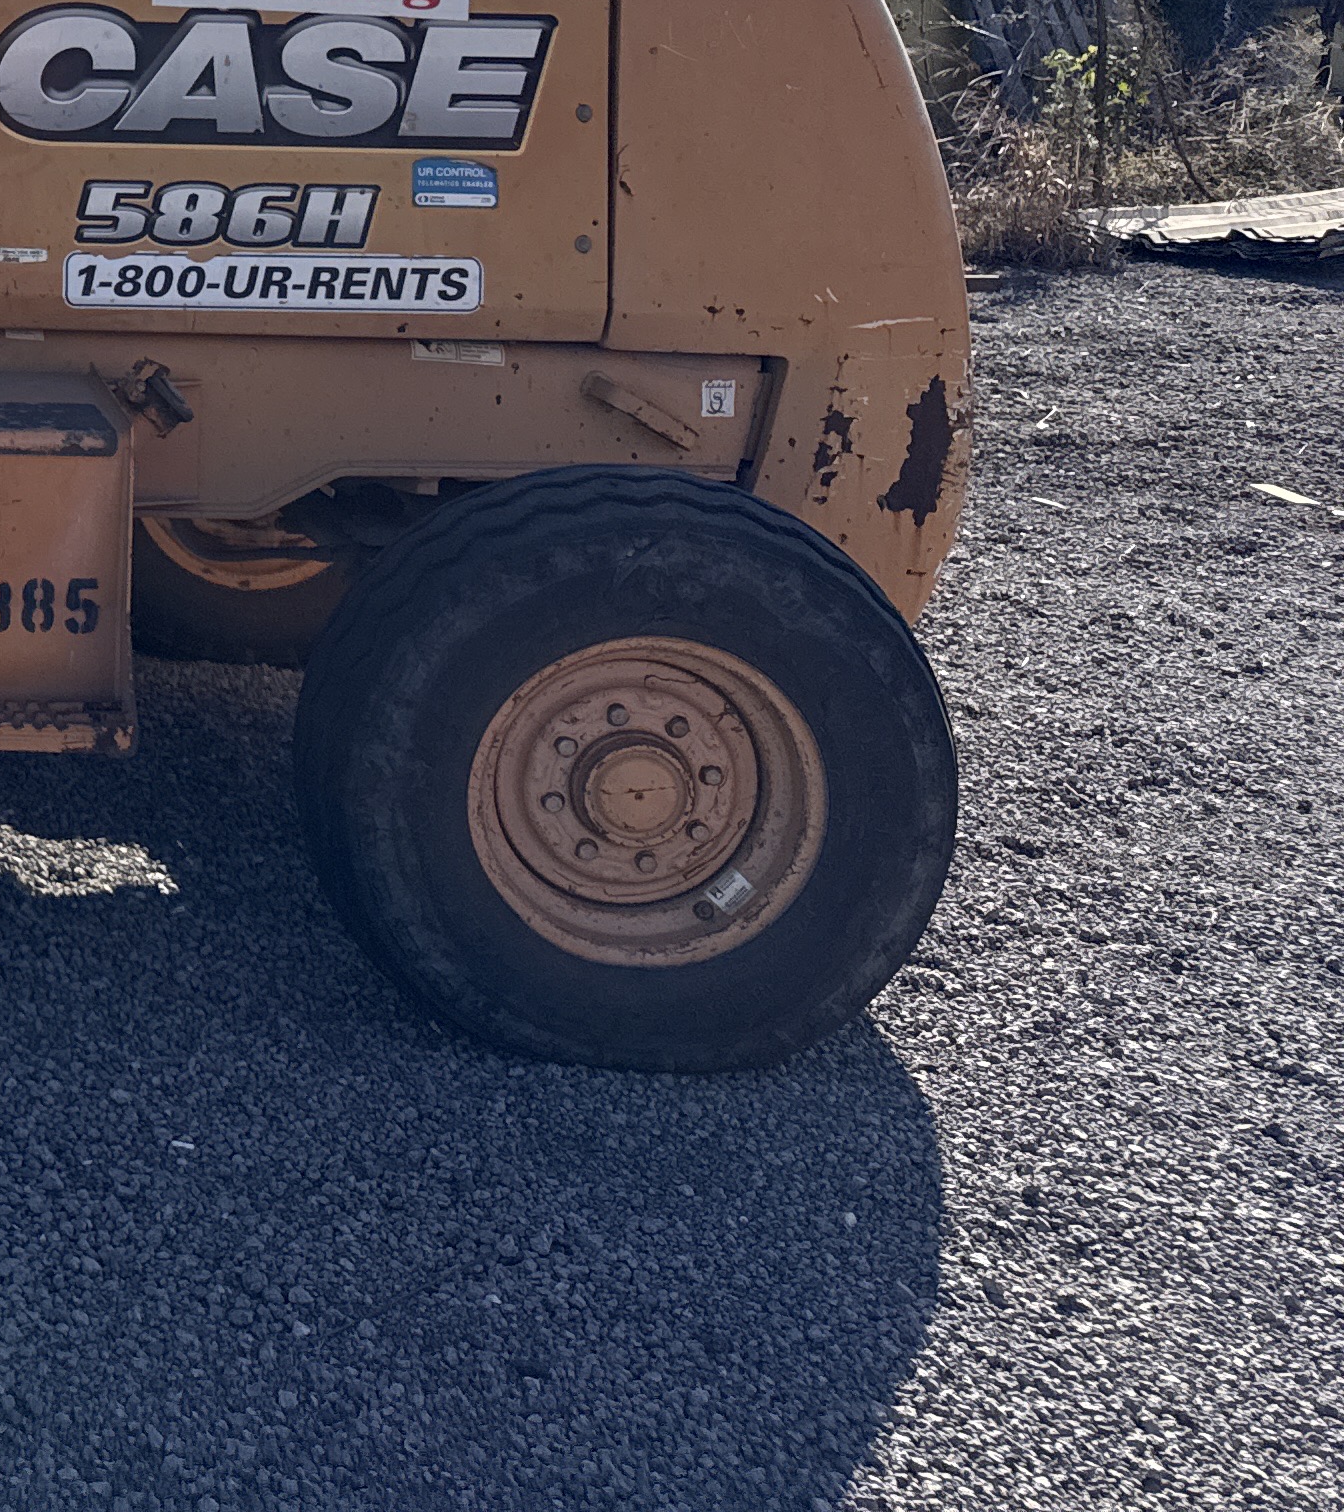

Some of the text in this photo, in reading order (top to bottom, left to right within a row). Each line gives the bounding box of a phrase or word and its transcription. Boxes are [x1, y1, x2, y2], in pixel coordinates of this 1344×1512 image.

[418, 168, 486, 177] UR CONTROL
[75, 181, 379, 249] 586H
[76, 264, 469, 301] 1-800-UR-RENTS
